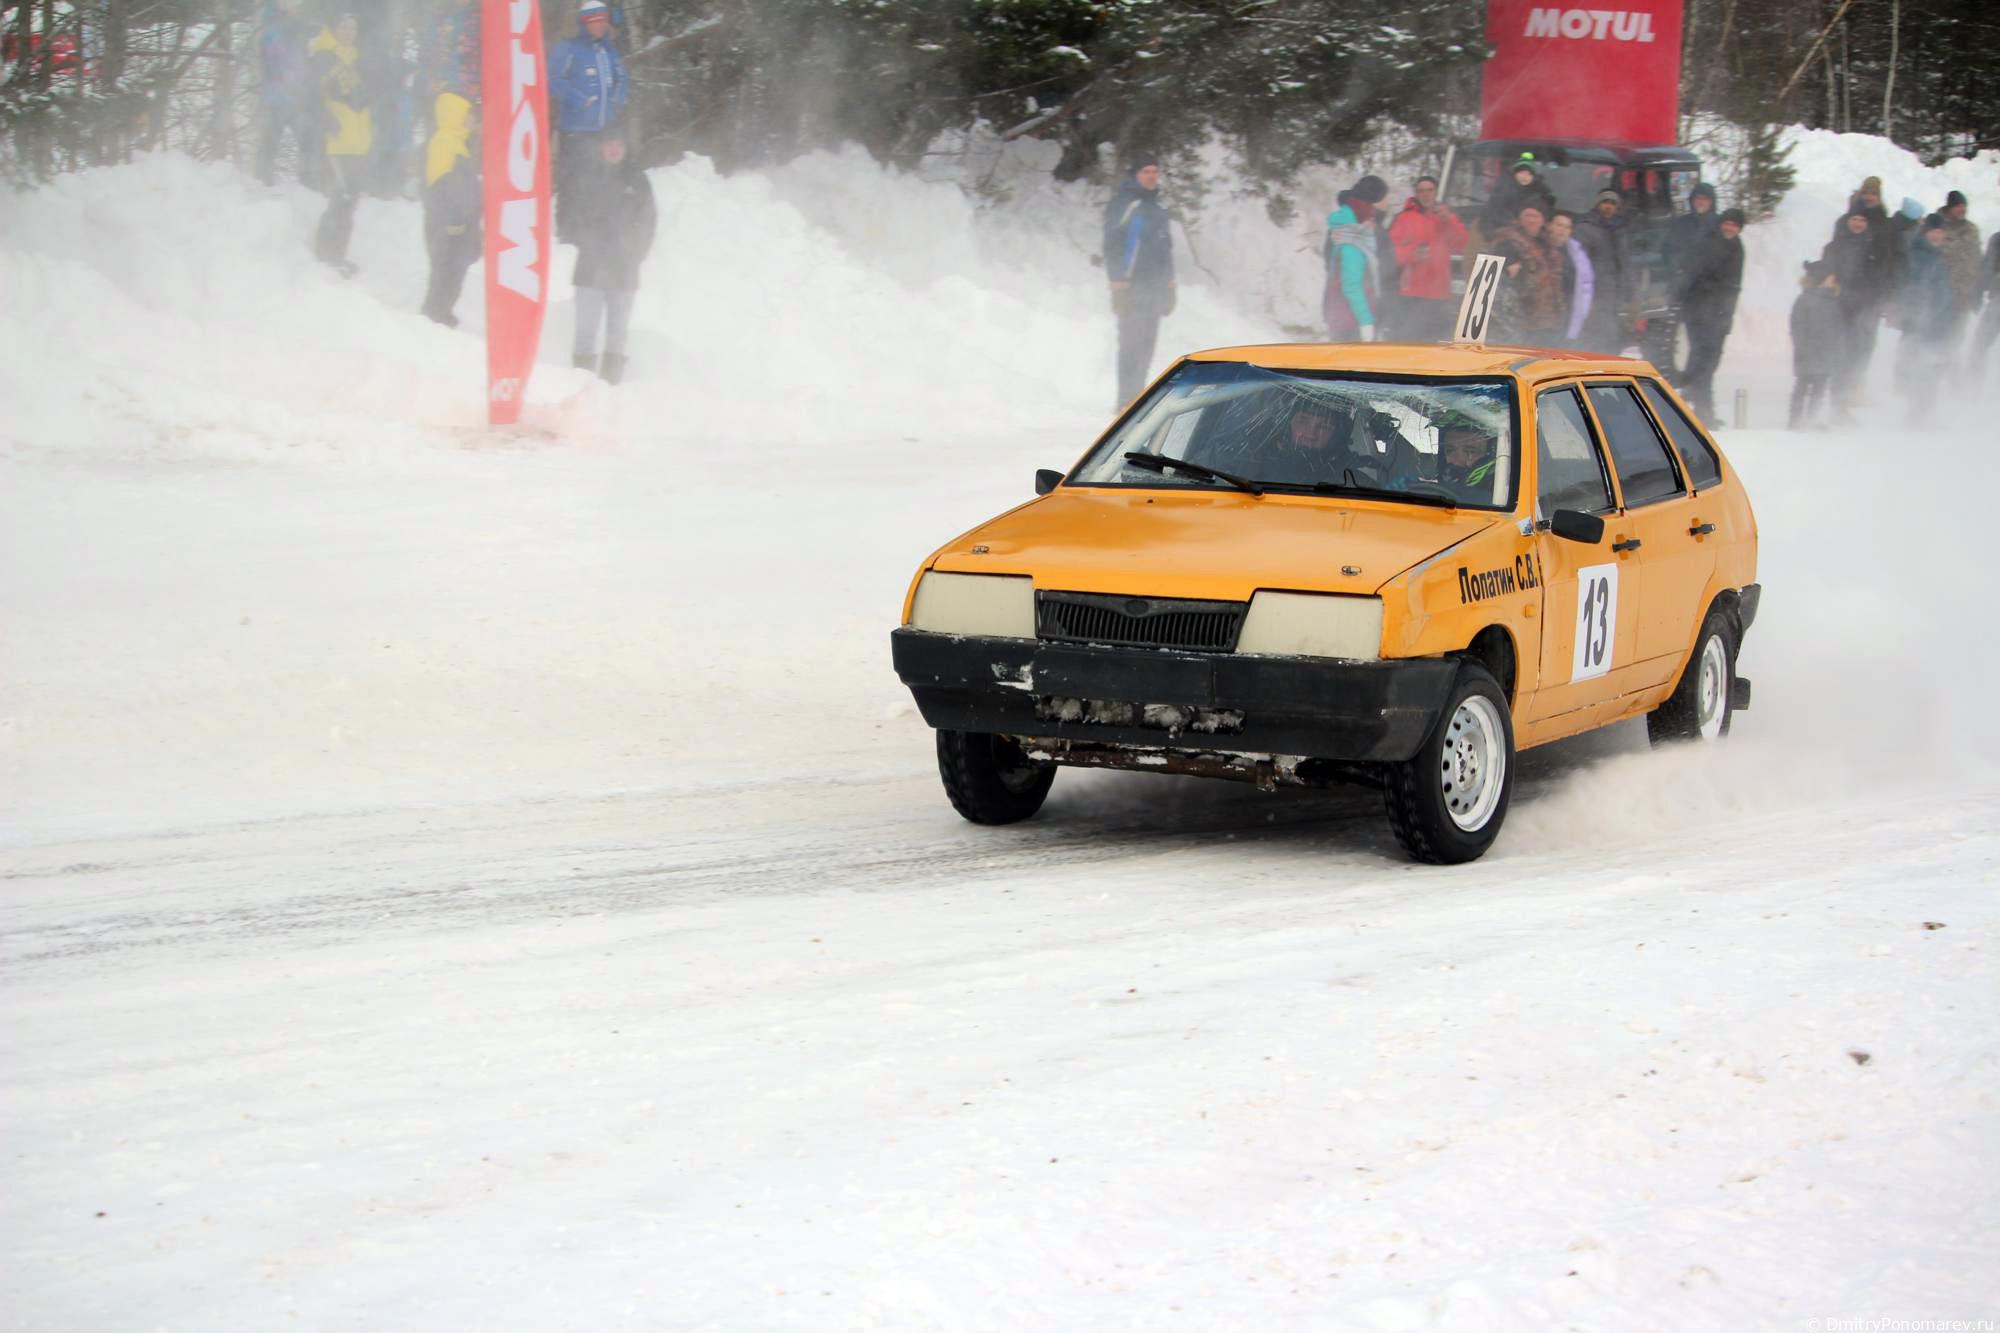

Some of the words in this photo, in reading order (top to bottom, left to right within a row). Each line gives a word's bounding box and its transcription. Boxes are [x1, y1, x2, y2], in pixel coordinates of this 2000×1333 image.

[1523, 8, 1656, 42] MOTUL
[1462, 259, 1498, 340] 13
[1458, 567, 1515, 604] Лопатин
[1515, 553, 1539, 590] С.В.
[1583, 576, 1609, 668] 13
